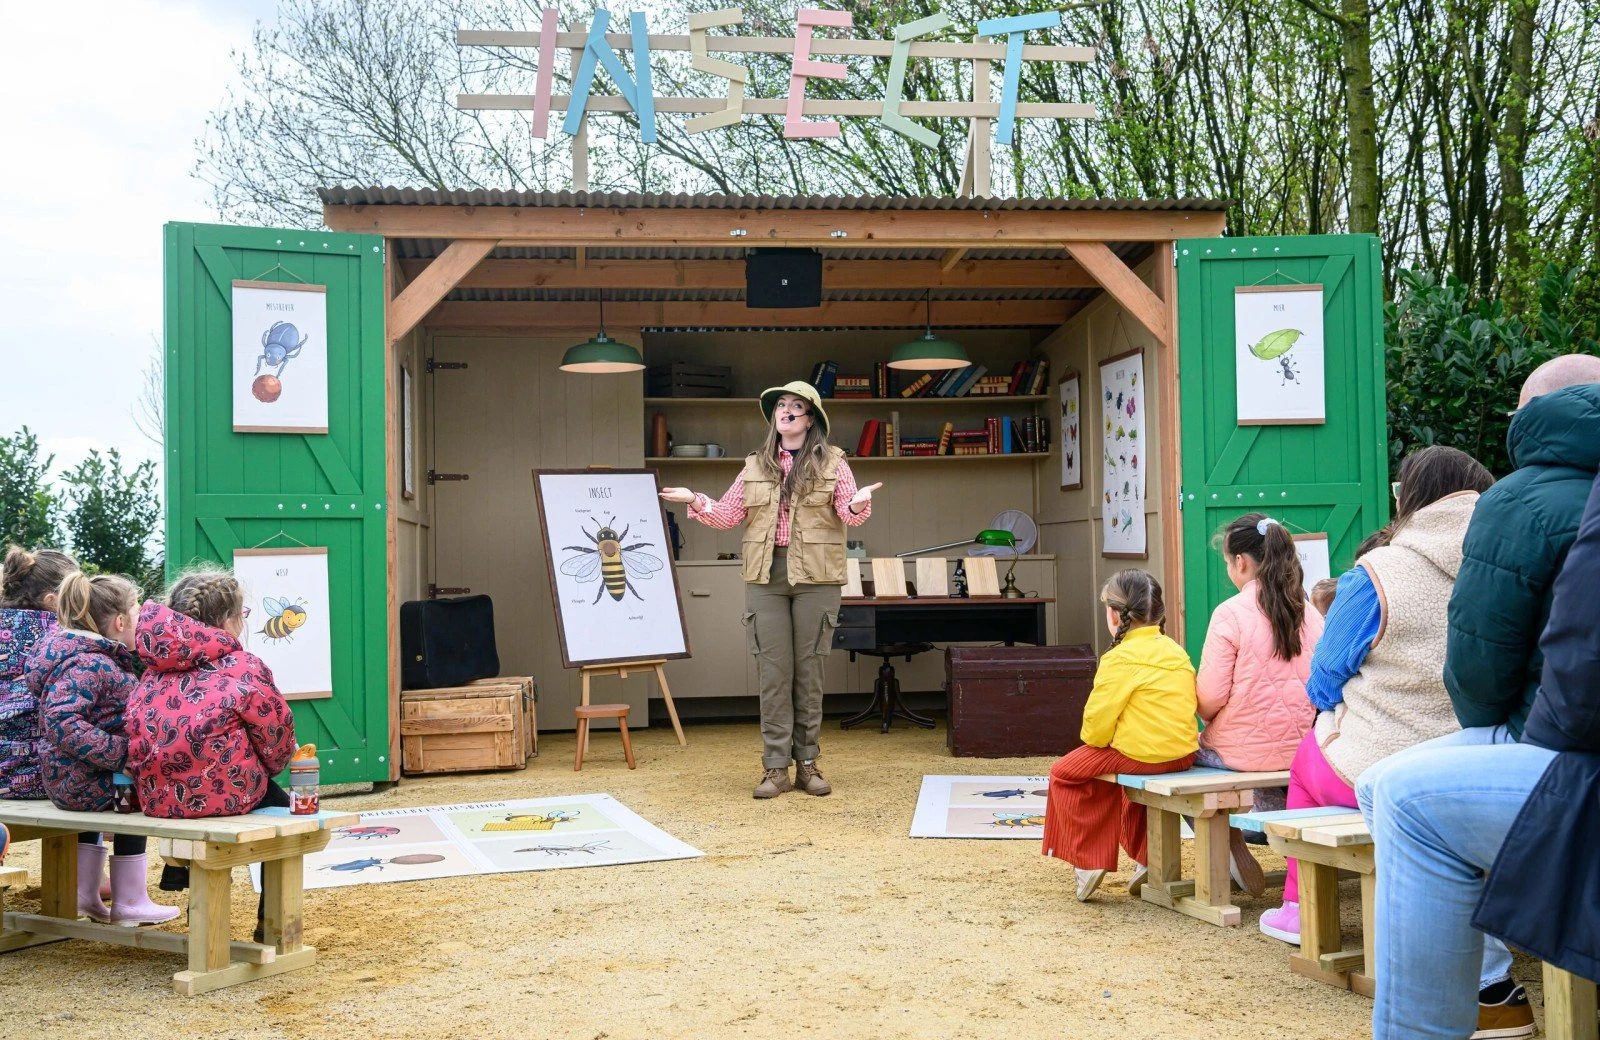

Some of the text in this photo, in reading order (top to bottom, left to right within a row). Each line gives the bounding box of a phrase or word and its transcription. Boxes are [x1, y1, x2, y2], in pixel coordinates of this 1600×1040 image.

[532, 8, 1062, 149] INSECT
[1273, 303, 1285, 311] MIER
[588, 487, 613, 499] INSECT
[275, 568, 288, 576] WESP
